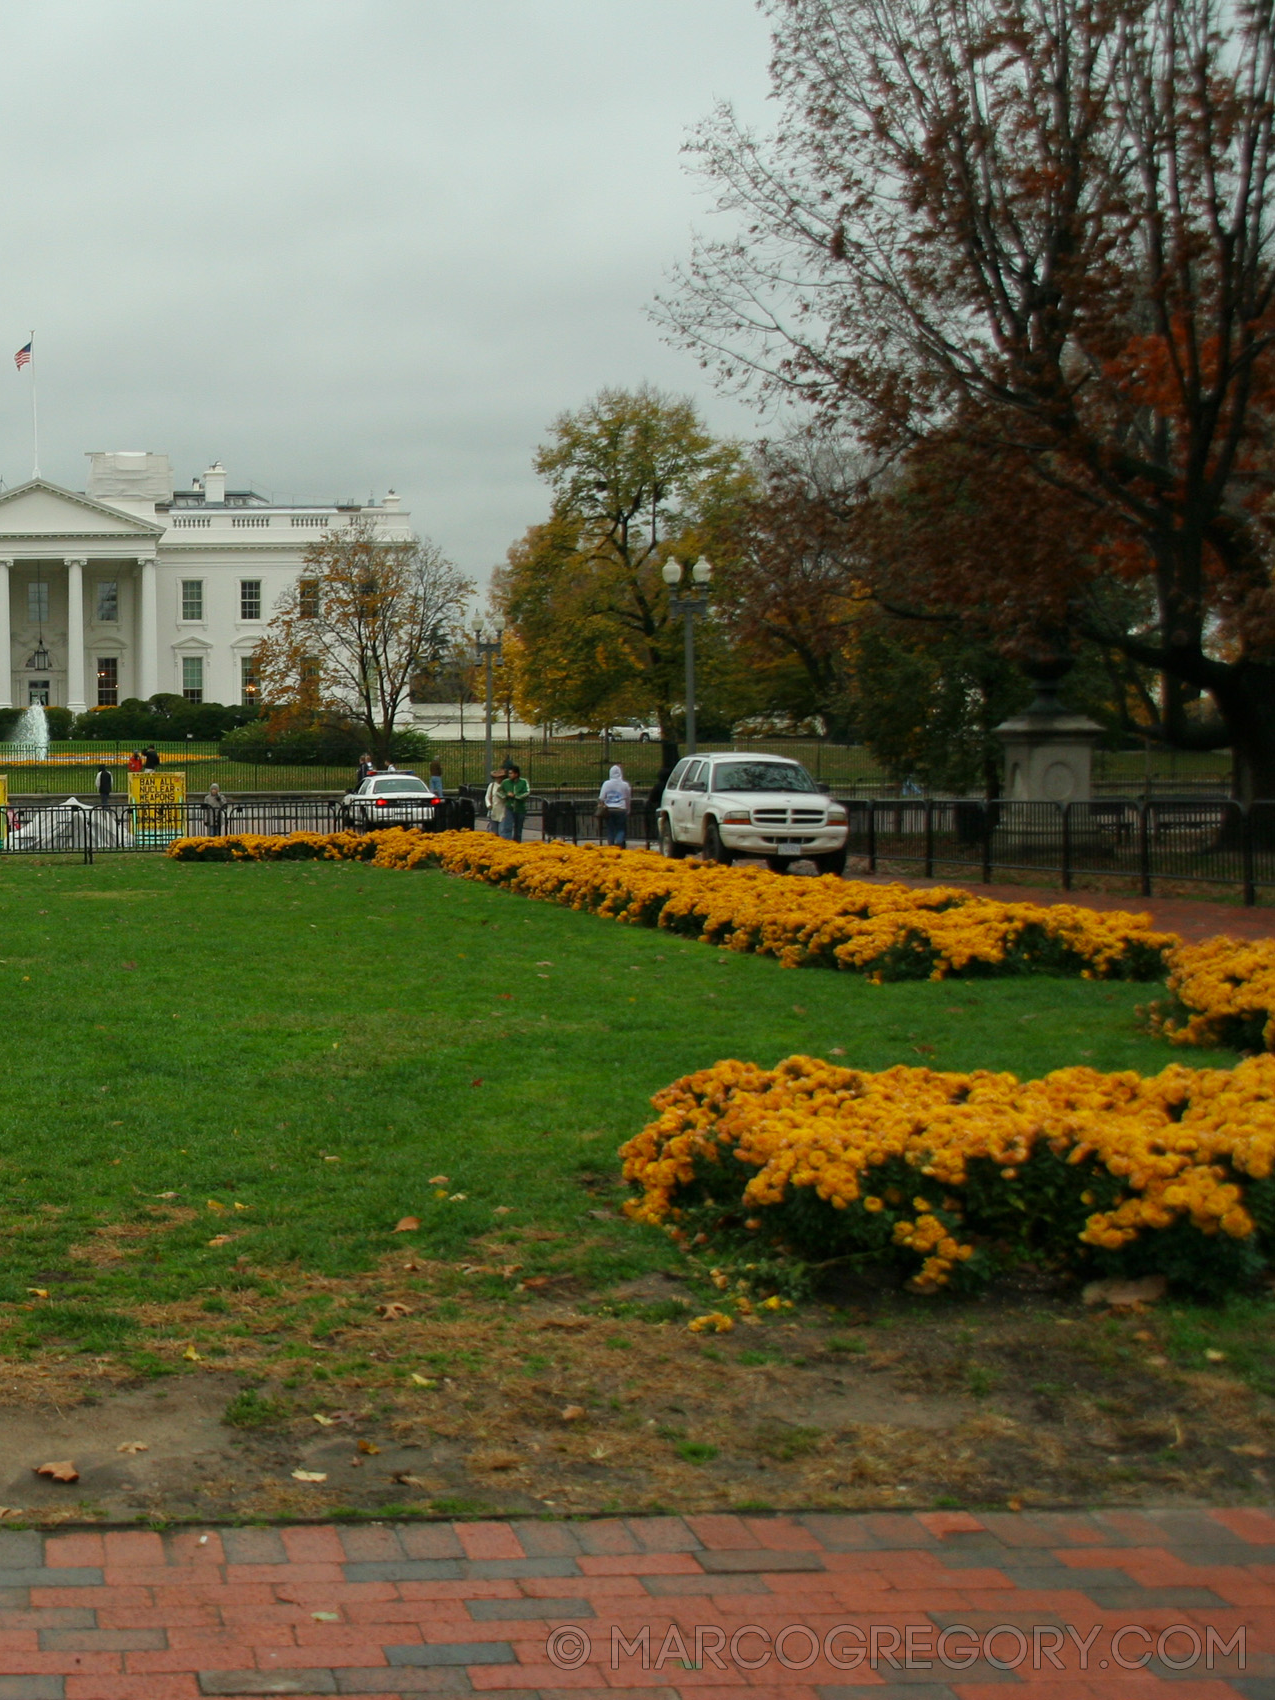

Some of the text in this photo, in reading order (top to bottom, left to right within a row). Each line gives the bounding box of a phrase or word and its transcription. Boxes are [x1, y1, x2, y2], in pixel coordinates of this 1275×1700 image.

[139, 778, 155, 786] BAN
[139, 785, 175, 793] NUCLEAR
[139, 793, 175, 801] WEAPONS
